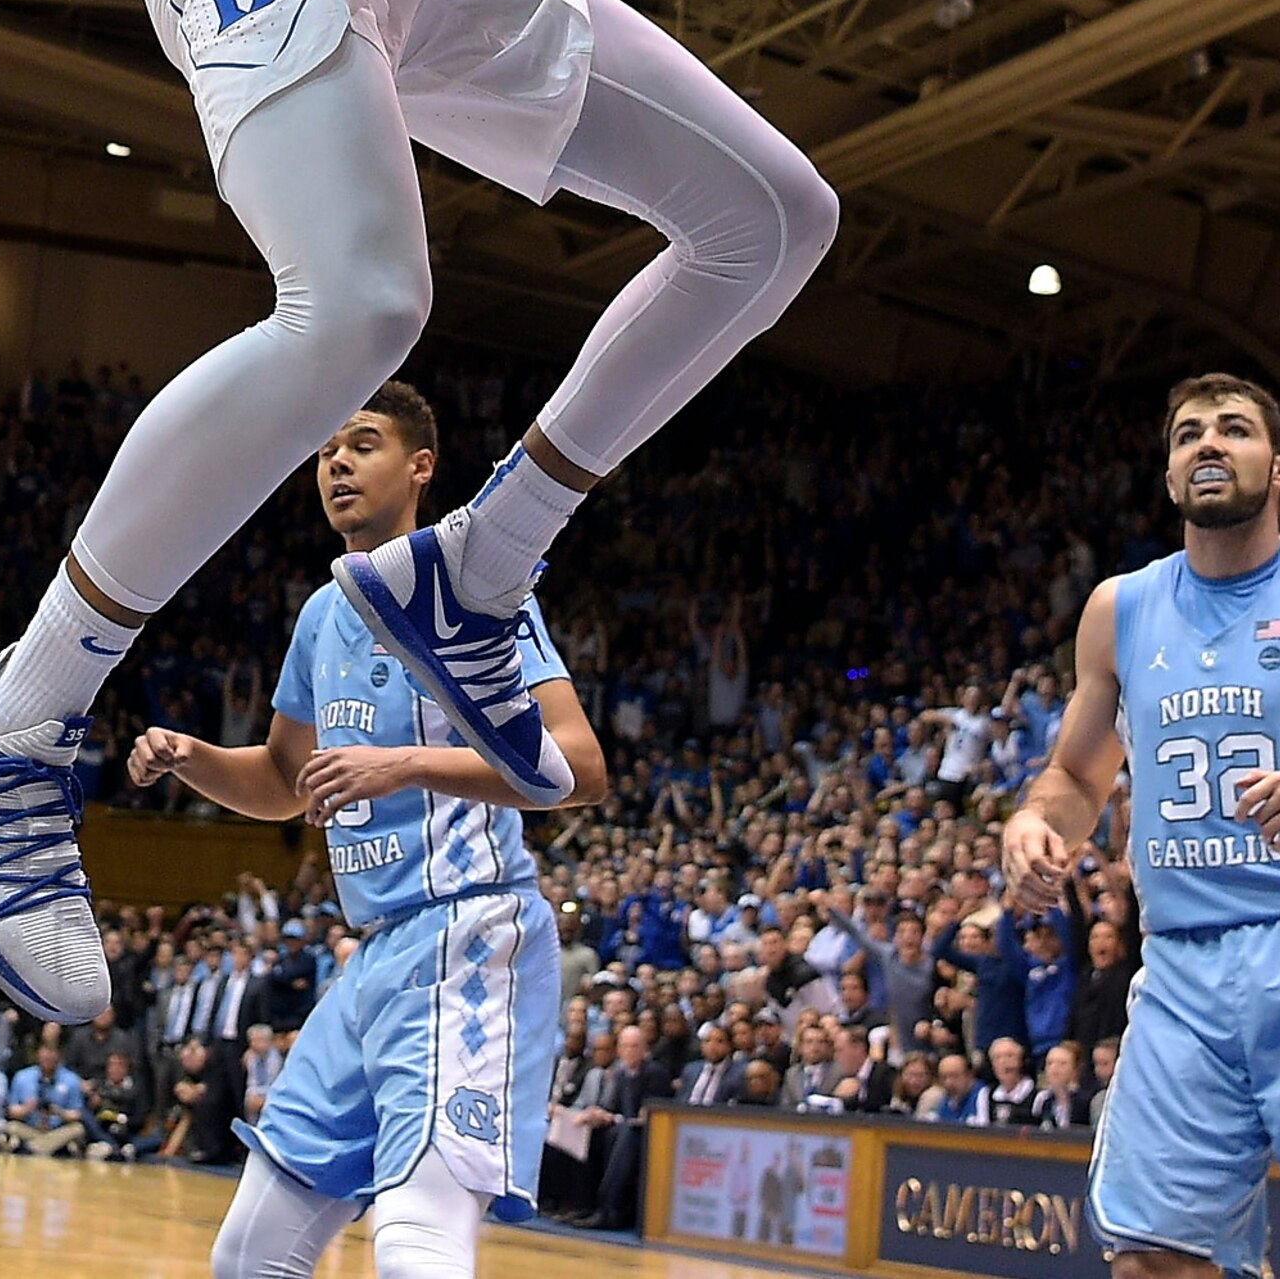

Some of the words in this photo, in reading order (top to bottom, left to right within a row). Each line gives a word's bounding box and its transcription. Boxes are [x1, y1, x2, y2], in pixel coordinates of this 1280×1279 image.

[1160, 685, 1264, 728] NORTH
[65, 727, 86, 741] 35
[1156, 731, 1278, 823] 32
